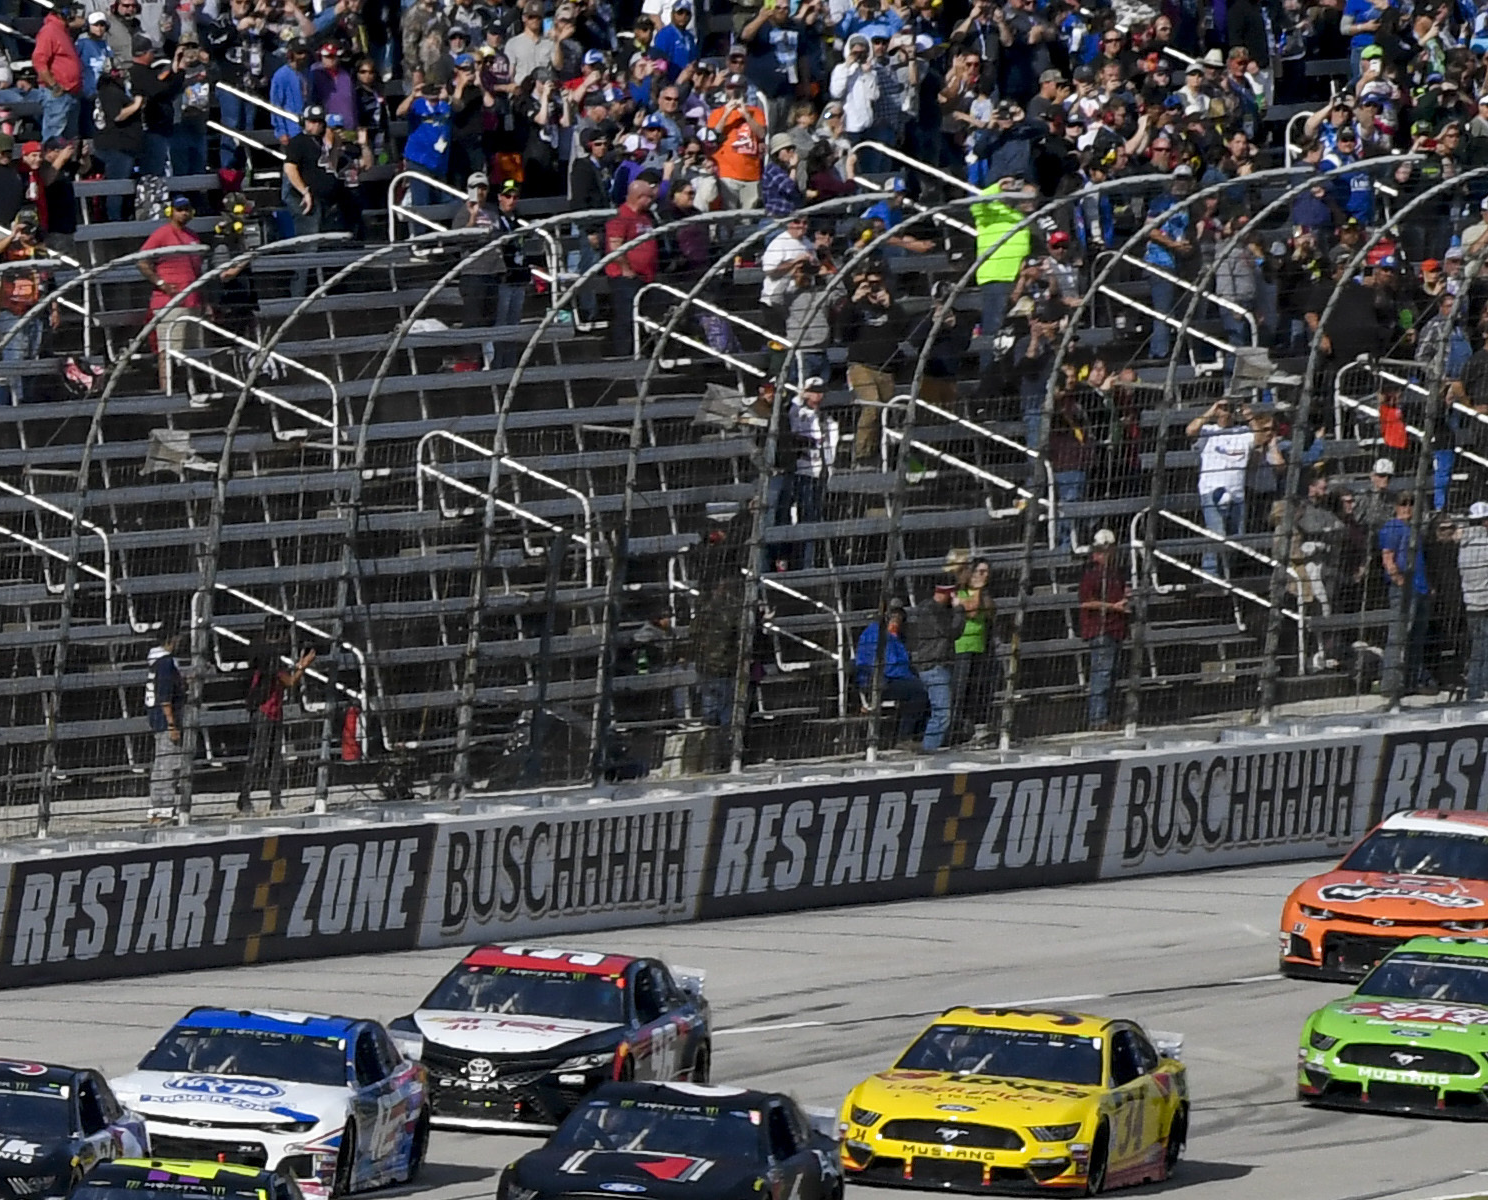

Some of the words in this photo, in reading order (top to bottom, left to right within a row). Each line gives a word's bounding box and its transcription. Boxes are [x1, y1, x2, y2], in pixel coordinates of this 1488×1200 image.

[713, 788, 938, 900] RESTART
[974, 772, 1104, 870] ZONE
[1122, 745, 1362, 867] BUSCHHHHH
[12, 853, 249, 967] RESTART
[286, 836, 420, 937] ZONE
[441, 810, 693, 931] BUSCHHHHH
[1358, 1067, 1450, 1085] MUSTANG
[903, 1143, 995, 1161] MUSTANG
